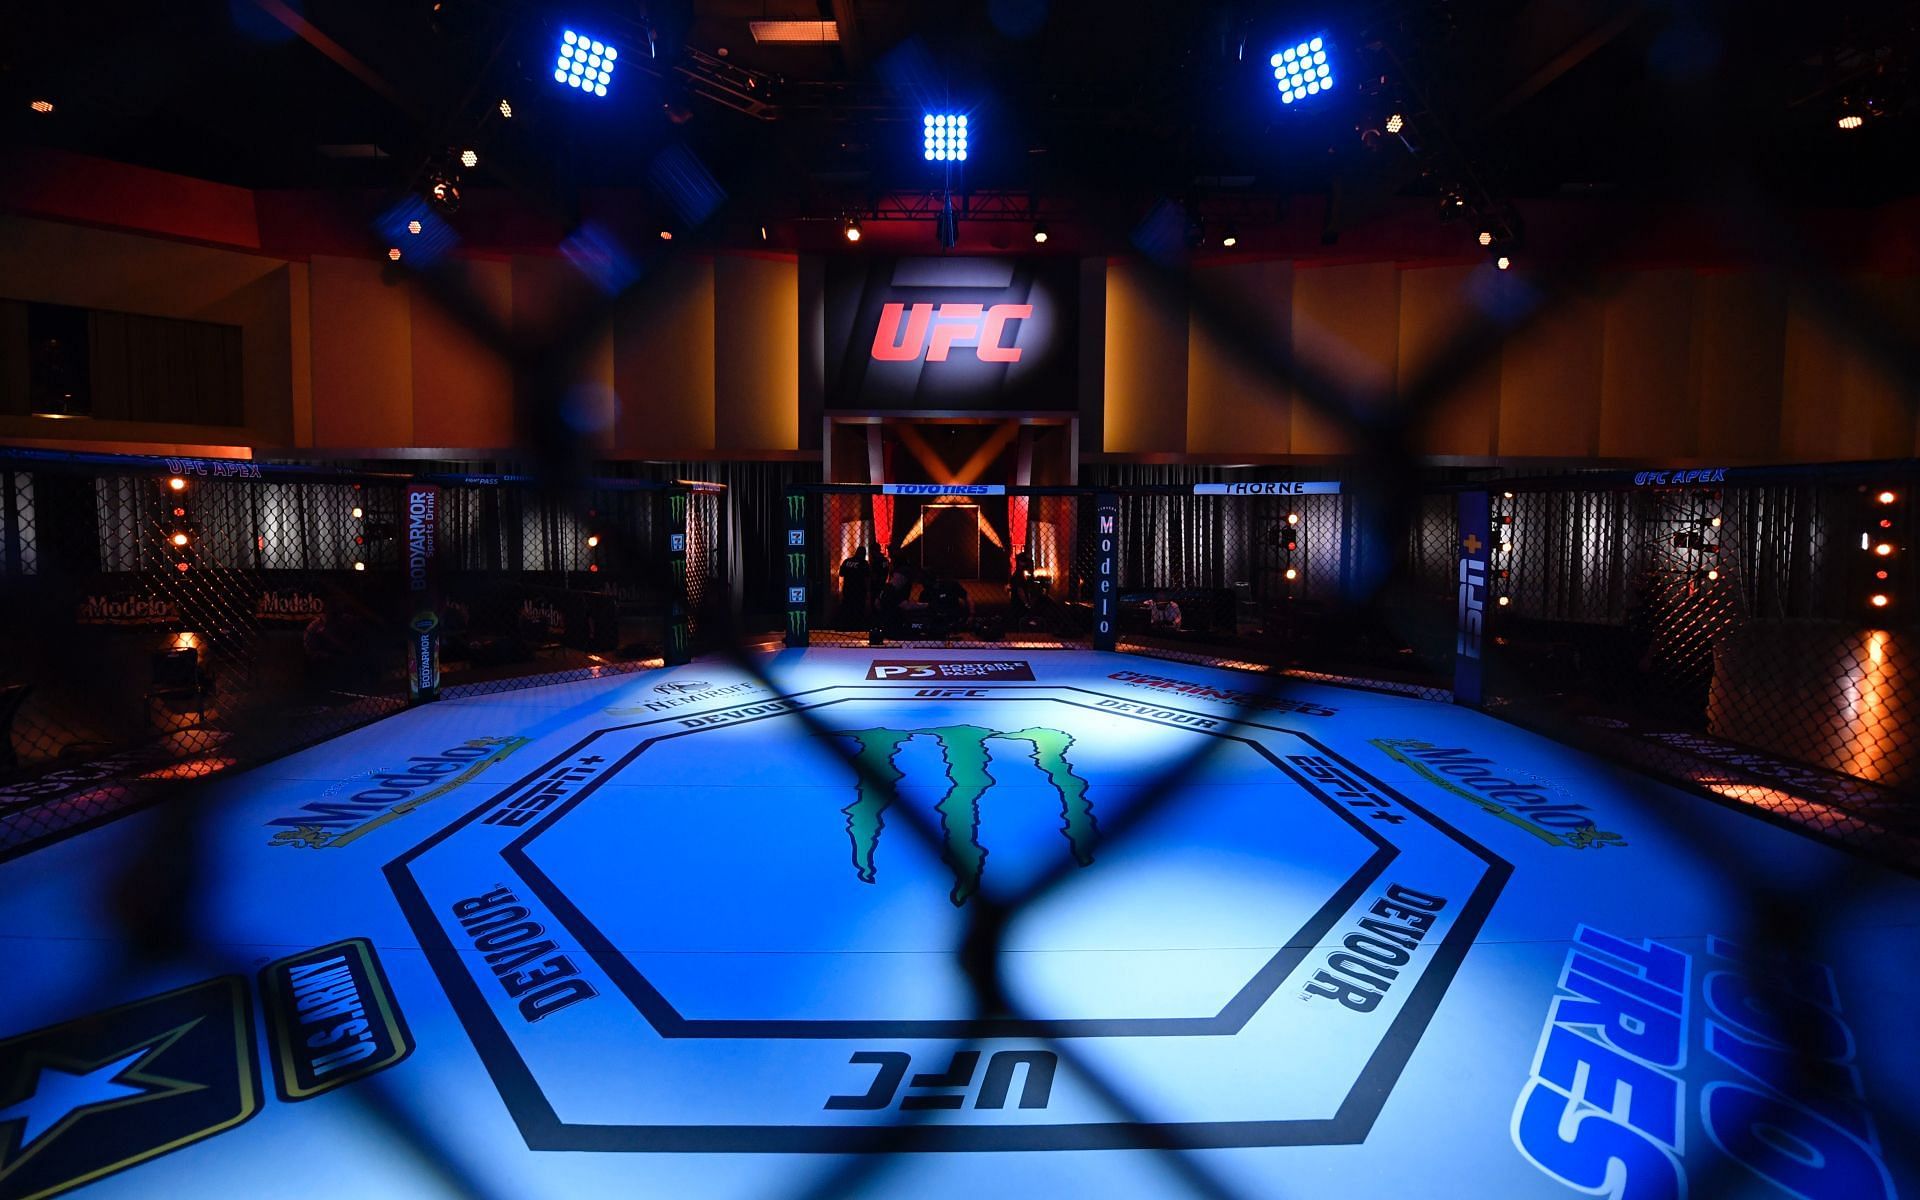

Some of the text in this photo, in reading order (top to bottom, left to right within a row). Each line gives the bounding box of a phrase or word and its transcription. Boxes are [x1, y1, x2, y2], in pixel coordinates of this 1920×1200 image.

[871, 303, 1034, 362] UFC
[166, 458, 263, 478] UFC APEX
[896, 485, 988, 493] TOYO TIRES
[1225, 482, 1304, 494] THORNE
[1634, 468, 1727, 486] UFC APEX
[410, 490, 427, 592] BODYARMOR
[425, 491, 435, 558] Sports Drink
[262, 593, 326, 614] Modelo
[1100, 515, 1114, 633] Modelo
[1456, 533, 1485, 660] ESPN+
[86, 596, 168, 618] Modelo
[421, 634, 432, 688] BODYARMOR
[875, 666, 936, 679] P3
[643, 682, 754, 712] NEMIROFF
[914, 689, 990, 697] UFC
[1096, 699, 1220, 729] DEVOUR
[265, 746, 491, 829] Modelo
[481, 755, 605, 827] ESPN+
[1286, 754, 1407, 825] ESPN+
[1402, 748, 1597, 828] Modelo
[452, 887, 600, 1024] DEVOUR
[1302, 882, 1448, 1013] DEVOUR
[823, 1050, 1057, 1109] UFC
[1510, 922, 1692, 1200] TIRES
